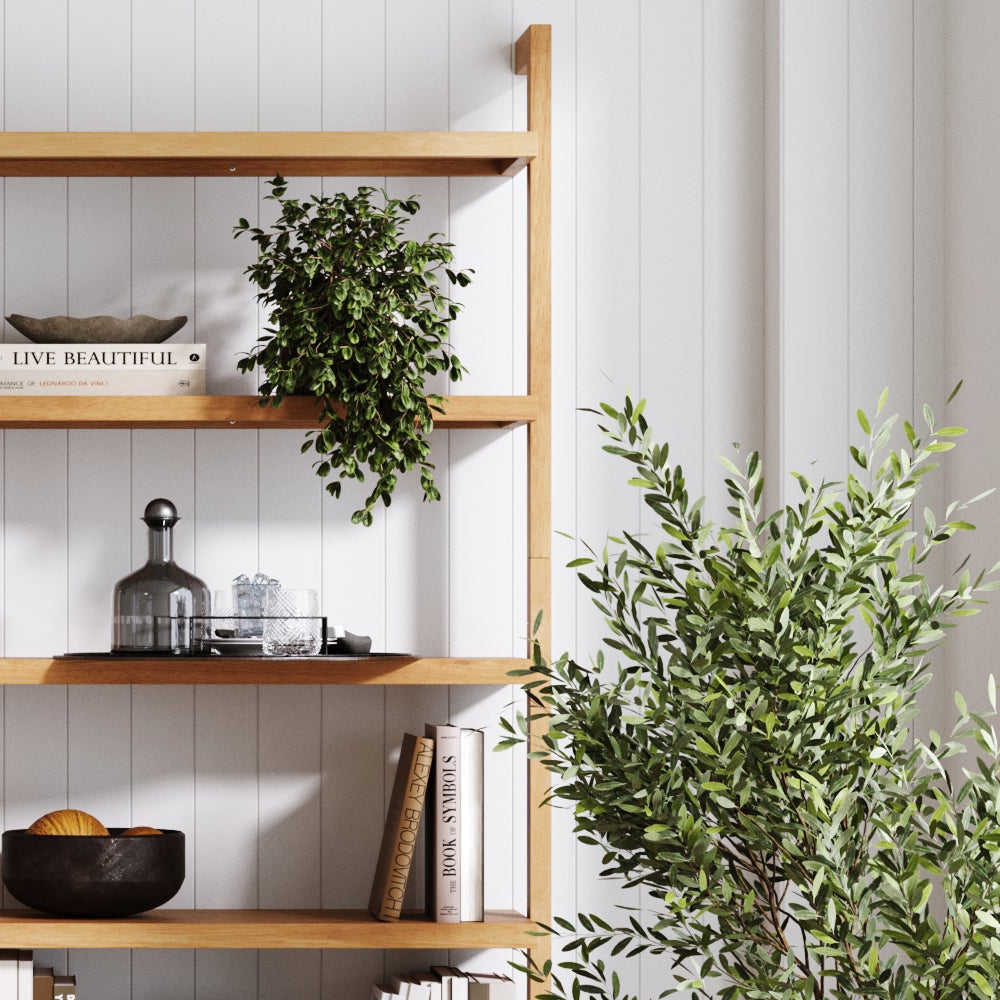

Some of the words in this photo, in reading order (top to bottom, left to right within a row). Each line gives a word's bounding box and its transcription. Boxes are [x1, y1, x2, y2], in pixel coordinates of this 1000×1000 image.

[13, 351, 56, 365] LIVE
[64, 351, 177, 365] BEAUTIFUL
[408, 741, 433, 806] ALEXEY
[442, 755, 457, 824] SYMBOLS
[450, 827, 457, 835] OF
[442, 839, 457, 877] BOOK
[449, 879, 457, 894] THE
